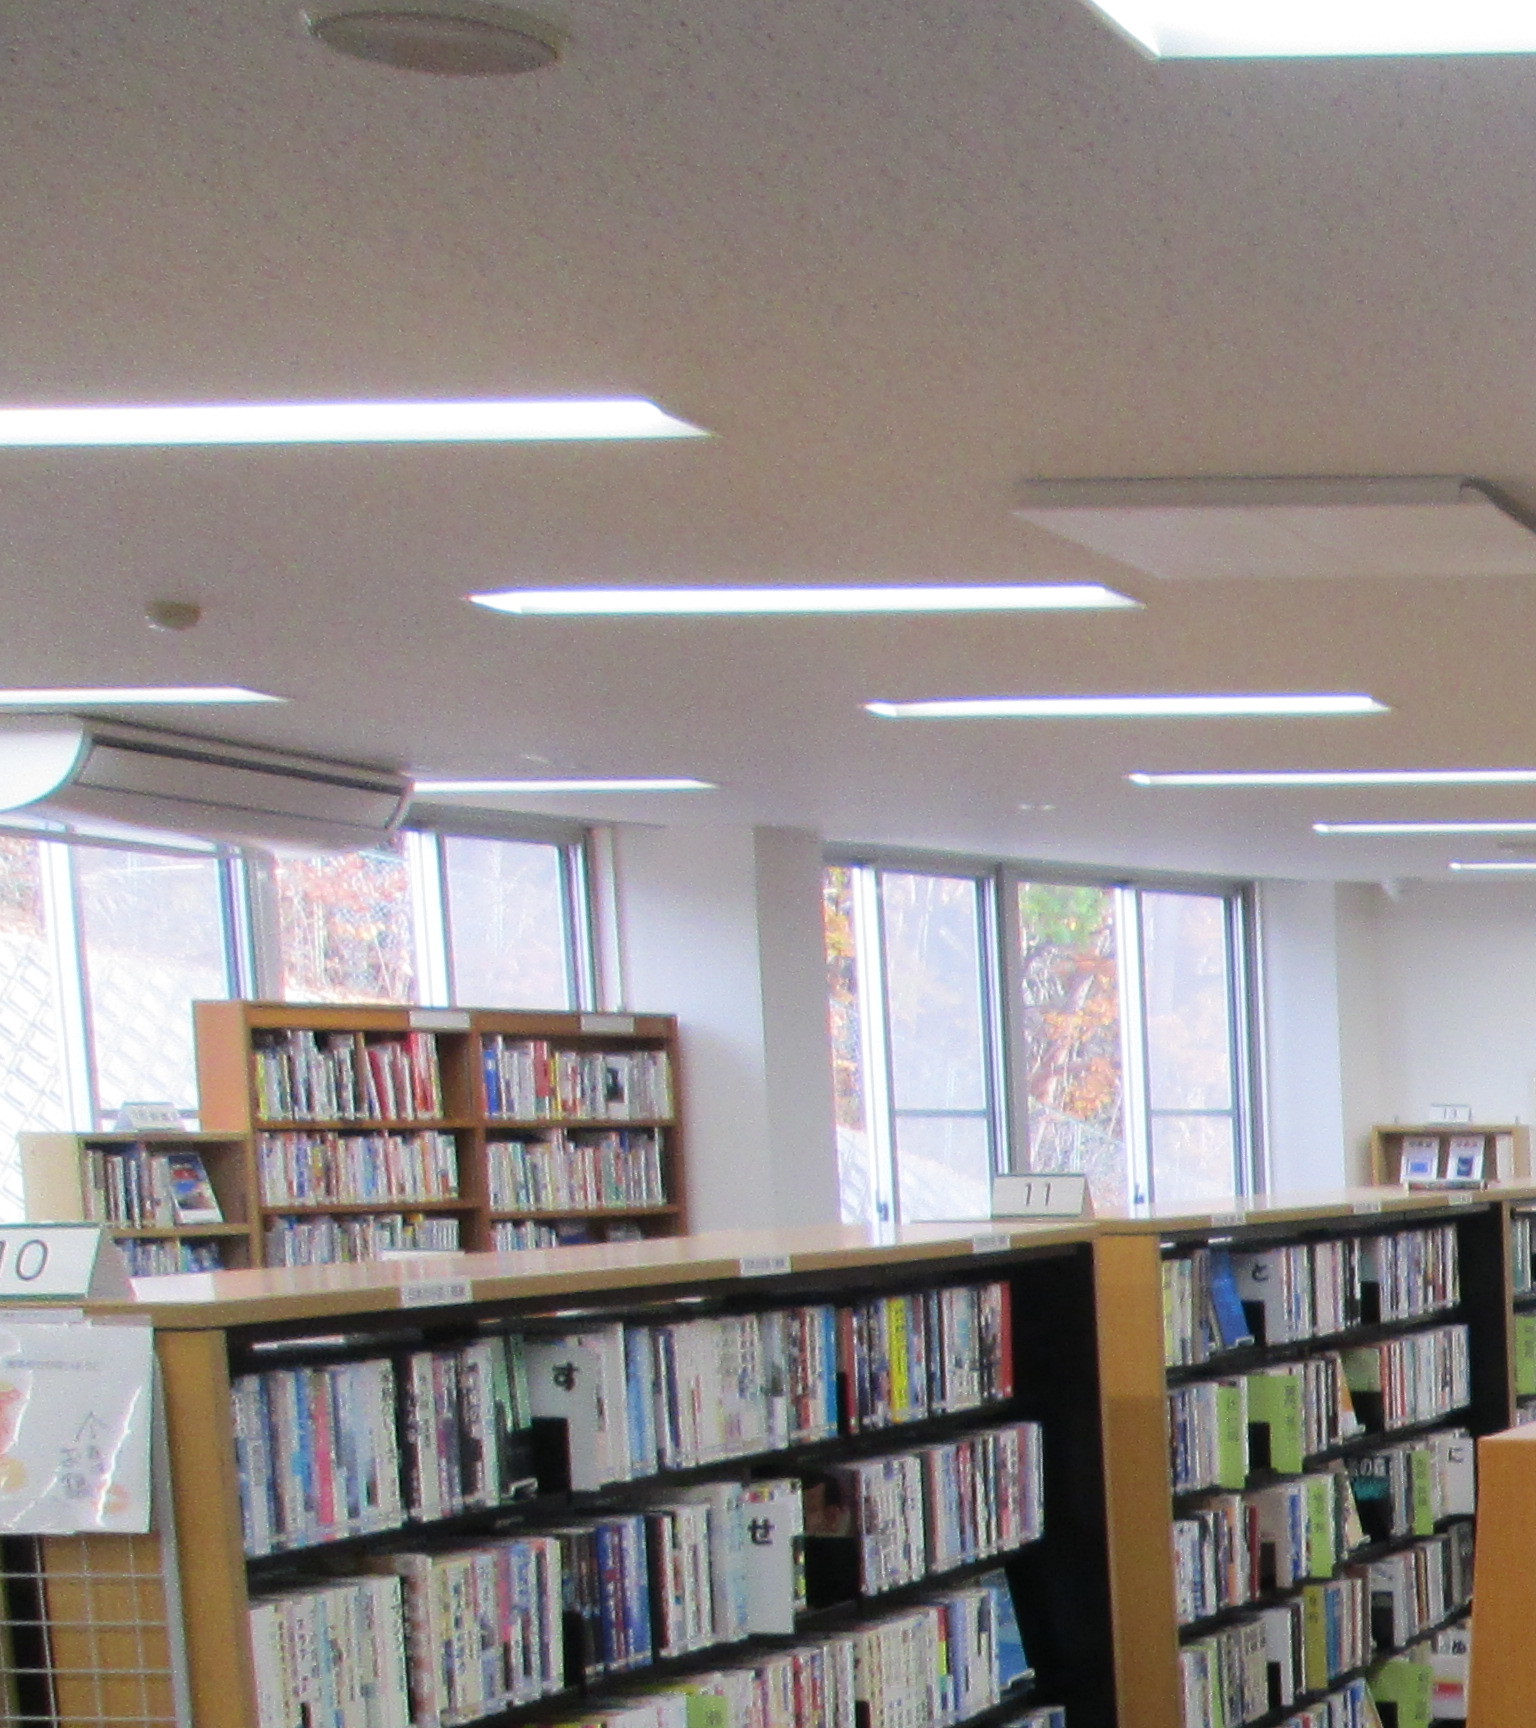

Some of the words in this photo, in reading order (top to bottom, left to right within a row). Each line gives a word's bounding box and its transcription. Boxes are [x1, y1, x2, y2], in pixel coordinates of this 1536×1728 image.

[1024, 1182, 1052, 1206] 11
[552, 1361, 578, 1392] す
[748, 1516, 775, 1546] せ
